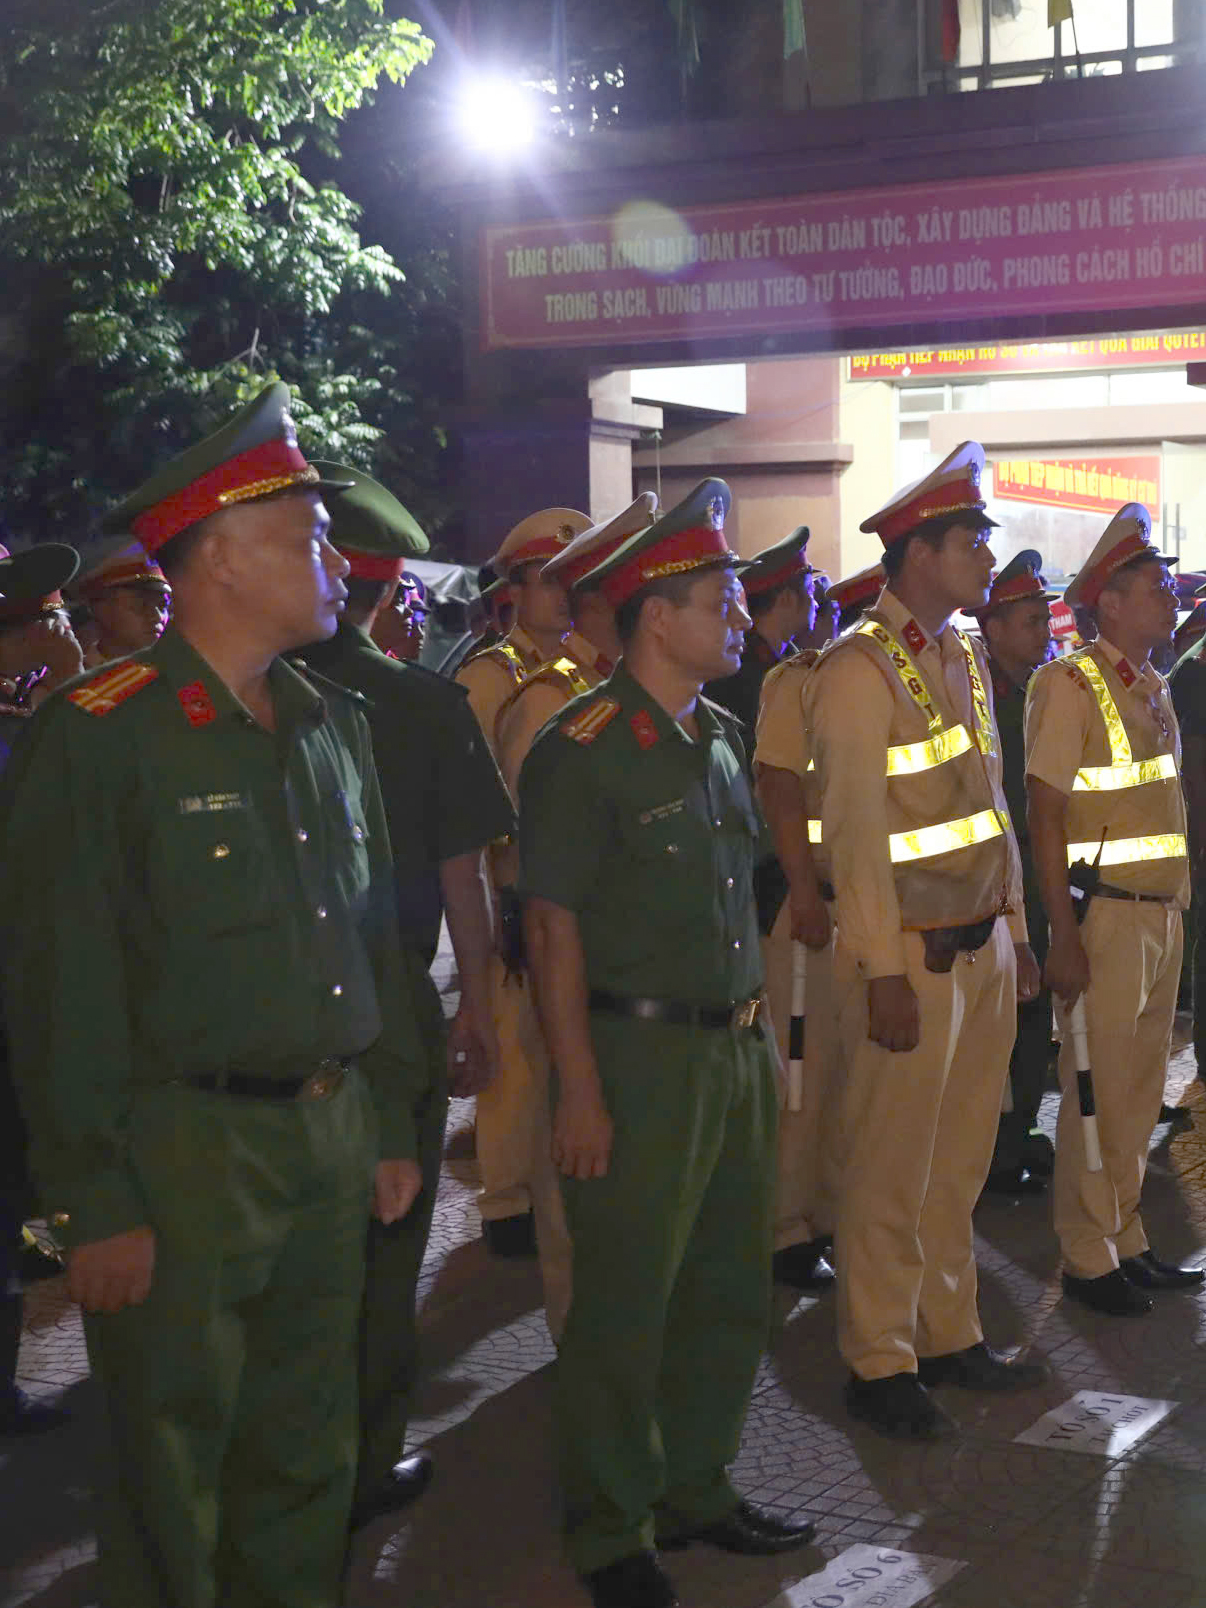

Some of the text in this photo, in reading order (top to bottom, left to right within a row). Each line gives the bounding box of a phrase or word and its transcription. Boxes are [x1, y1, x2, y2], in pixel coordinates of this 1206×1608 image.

[739, 220, 772, 258] KẾT
[775, 218, 824, 256] TOÀN
[828, 214, 866, 252] DÂN
[870, 208, 912, 253] TỘC,
[917, 205, 953, 244] XÂY
[958, 204, 1012, 246] DỰNG
[1016, 192, 1072, 236] ĐẢNG
[1077, 191, 1103, 230] VÀ
[1109, 187, 1135, 233] HỆ
[544, 292, 598, 323] TRONG
[602, 288, 652, 324] SẠCH,
[706, 280, 760, 317] MẠNH
[763, 275, 808, 307] THEO
[911, 263, 948, 301] ĐẠO
[954, 254, 998, 293] ĐỨC,
[1003, 254, 1071, 290] PHONG
[1076, 245, 1130, 284] CÁCH
[1136, 236, 1163, 279] HỒ
[1169, 236, 1205, 277] CHÍ
[873, 628, 936, 720] CSGT
[877, 1553, 902, 1564] 6
